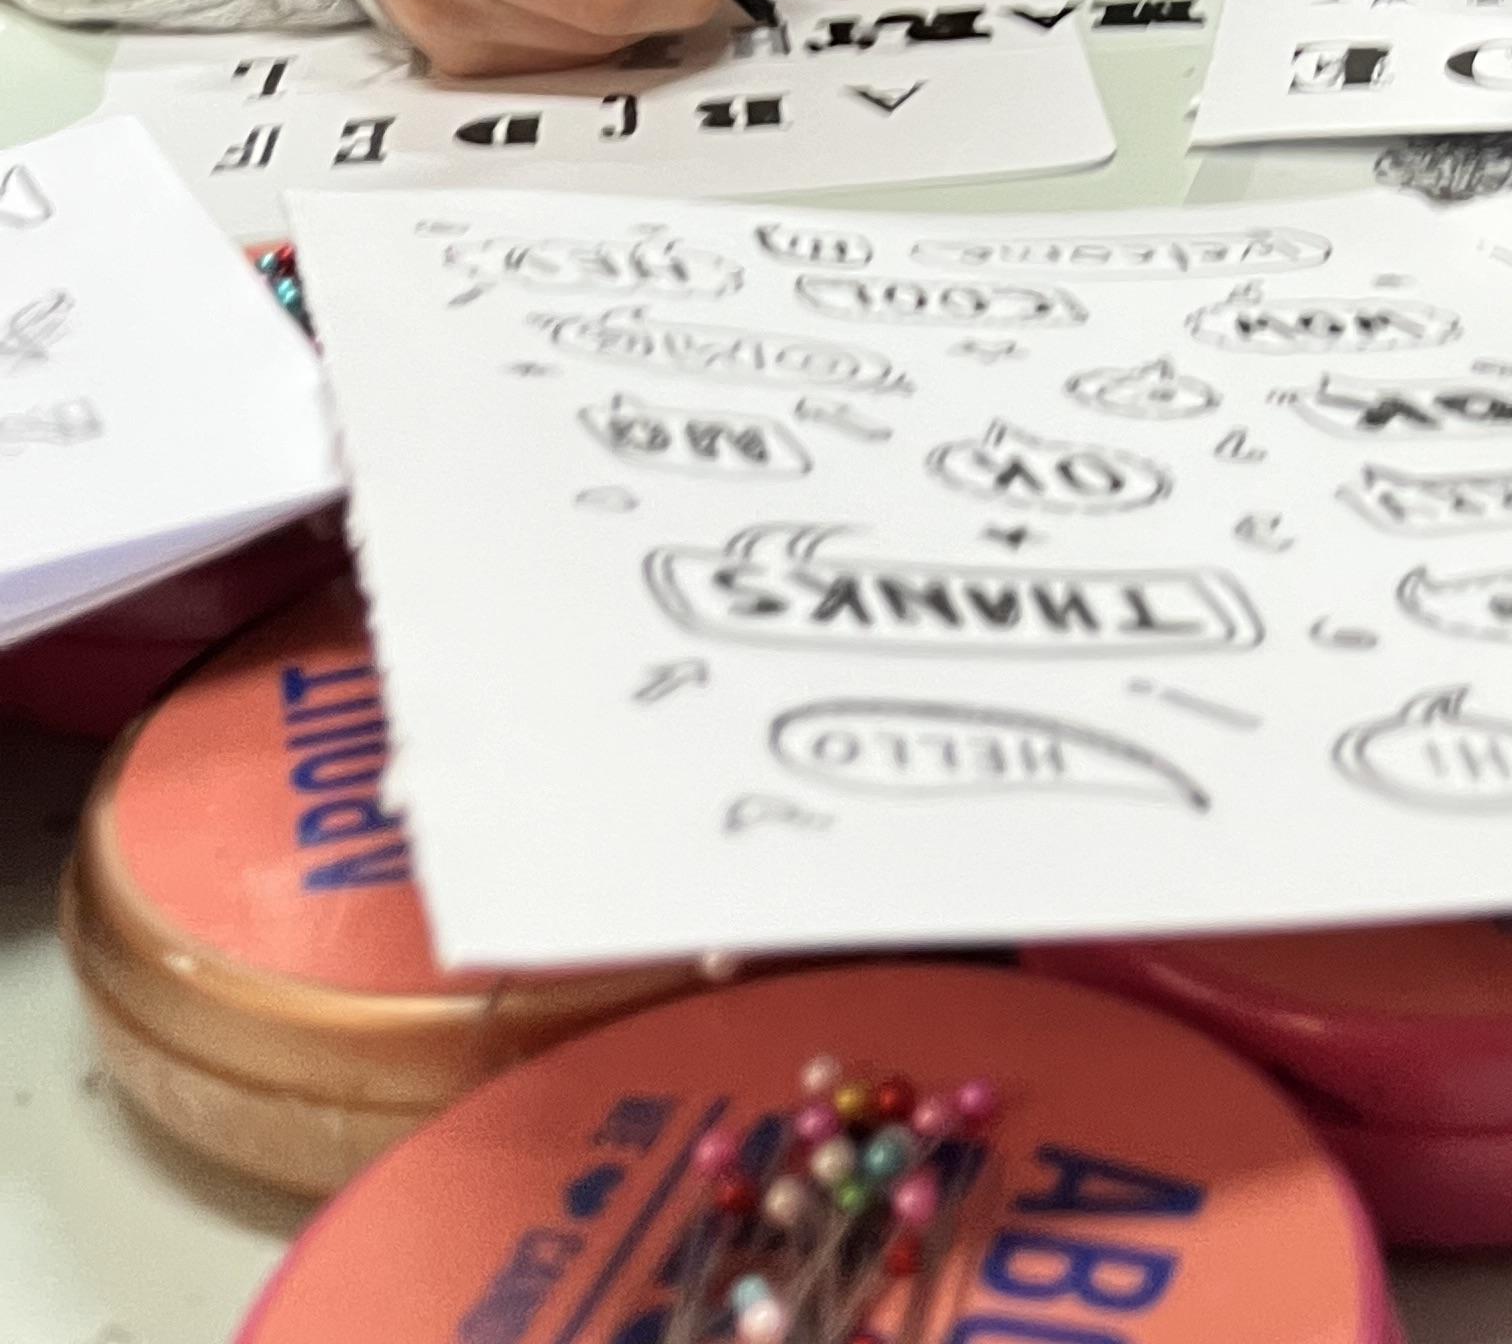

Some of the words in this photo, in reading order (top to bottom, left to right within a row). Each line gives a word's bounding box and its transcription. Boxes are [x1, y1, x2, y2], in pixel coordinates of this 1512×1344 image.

[1288, 40, 1393, 94] E
[455, 112, 543, 146] D
[600, 94, 641, 139] C
[697, 91, 796, 131] B
[331, 115, 395, 167] E
[712, 562, 1203, 636] THANKS
[810, 732, 1070, 780] HELLO
